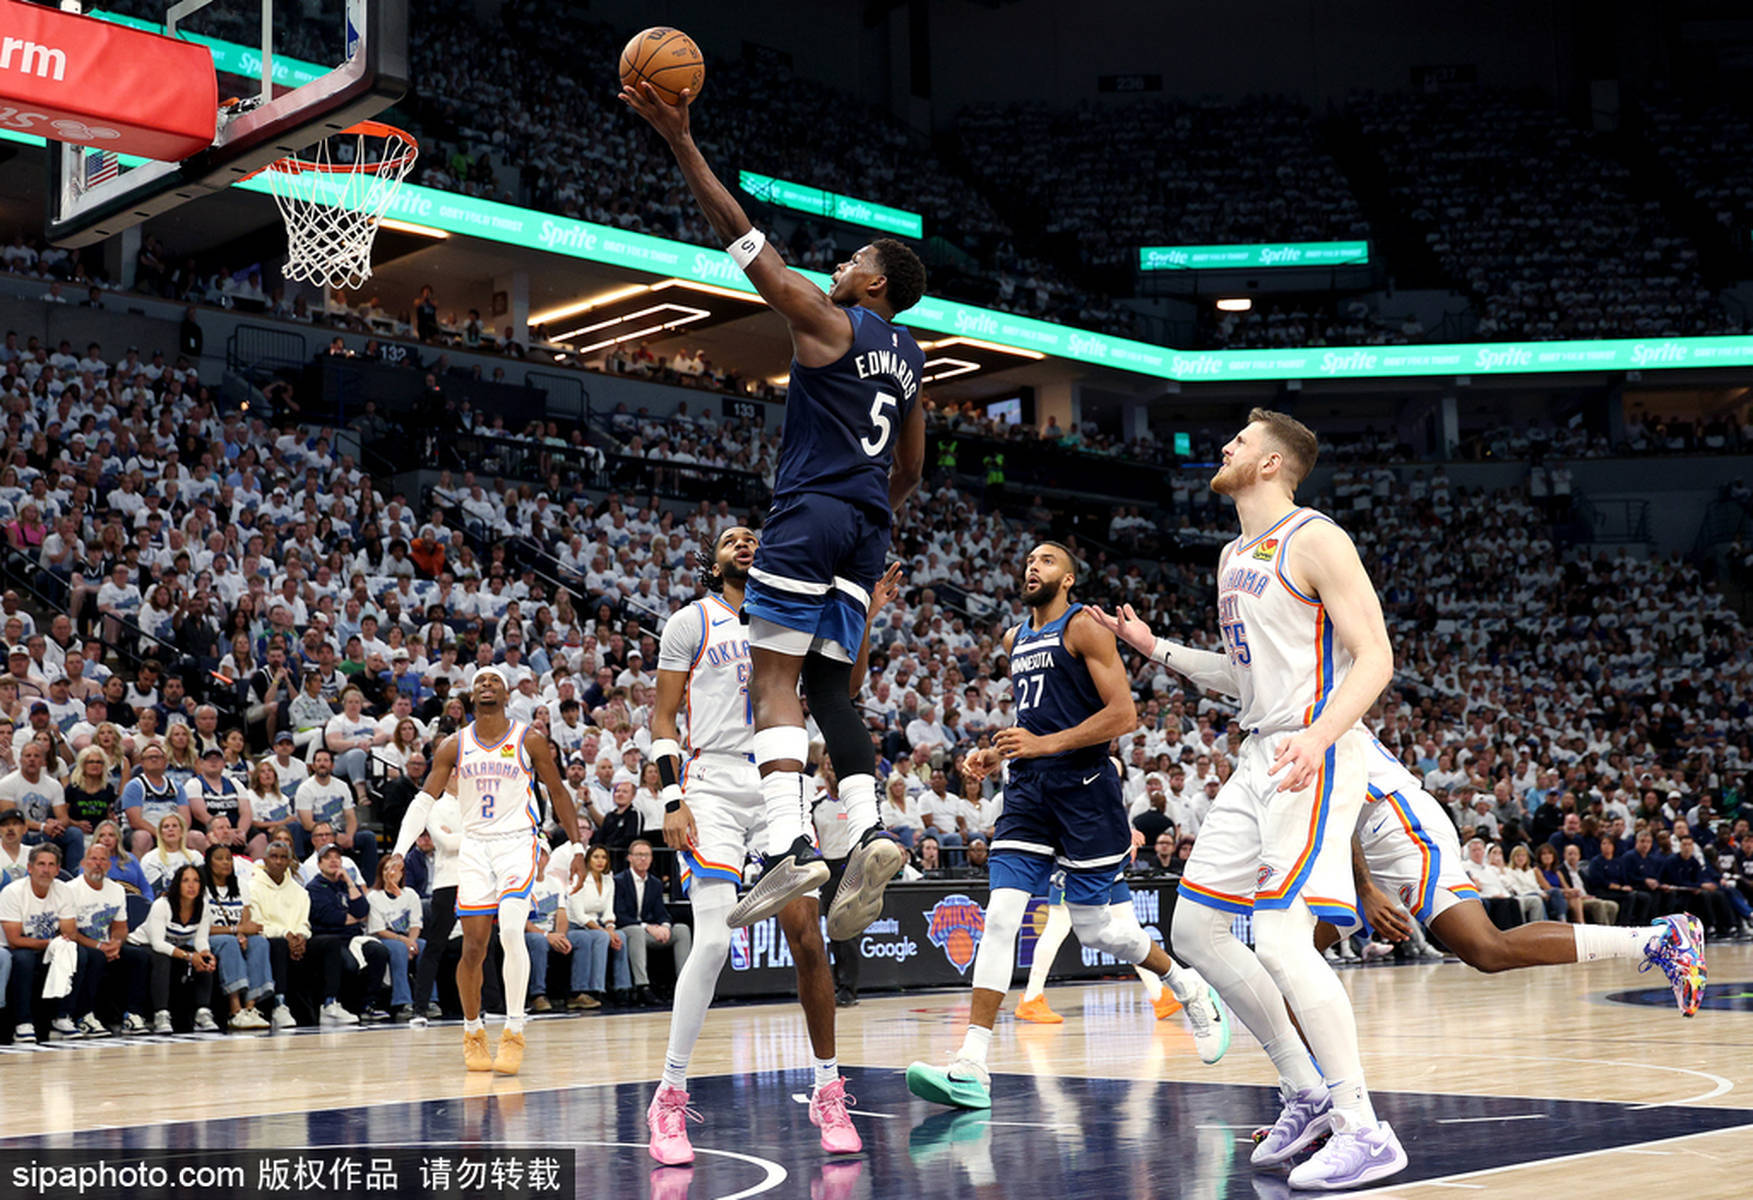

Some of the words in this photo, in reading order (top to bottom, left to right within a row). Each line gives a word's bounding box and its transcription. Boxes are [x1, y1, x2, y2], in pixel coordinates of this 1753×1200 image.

[238, 52, 290, 79] Spte
[837, 200, 873, 222] Sprite
[538, 219, 598, 251] Sprite
[691, 253, 745, 282] Sprite
[1147, 250, 1189, 267] Sprite
[1259, 247, 1301, 265] Sprite
[953, 308, 999, 334] Sprite
[380, 345, 407, 361] 132
[1067, 333, 1108, 358] Sprite
[1630, 342, 1688, 365] Sprite
[1170, 355, 1223, 377] Sprite
[1320, 350, 1377, 375] Sprite
[1475, 347, 1532, 370] Sprite
[855, 350, 917, 400] EDWARDS
[861, 391, 897, 457] 5
[707, 639, 752, 668] OKLA
[1018, 674, 1045, 712] 27
[460, 760, 521, 780] OKLAHOMA
[475, 778, 502, 793] CITY
[481, 794, 496, 819] 2
[861, 936, 918, 962] Google
